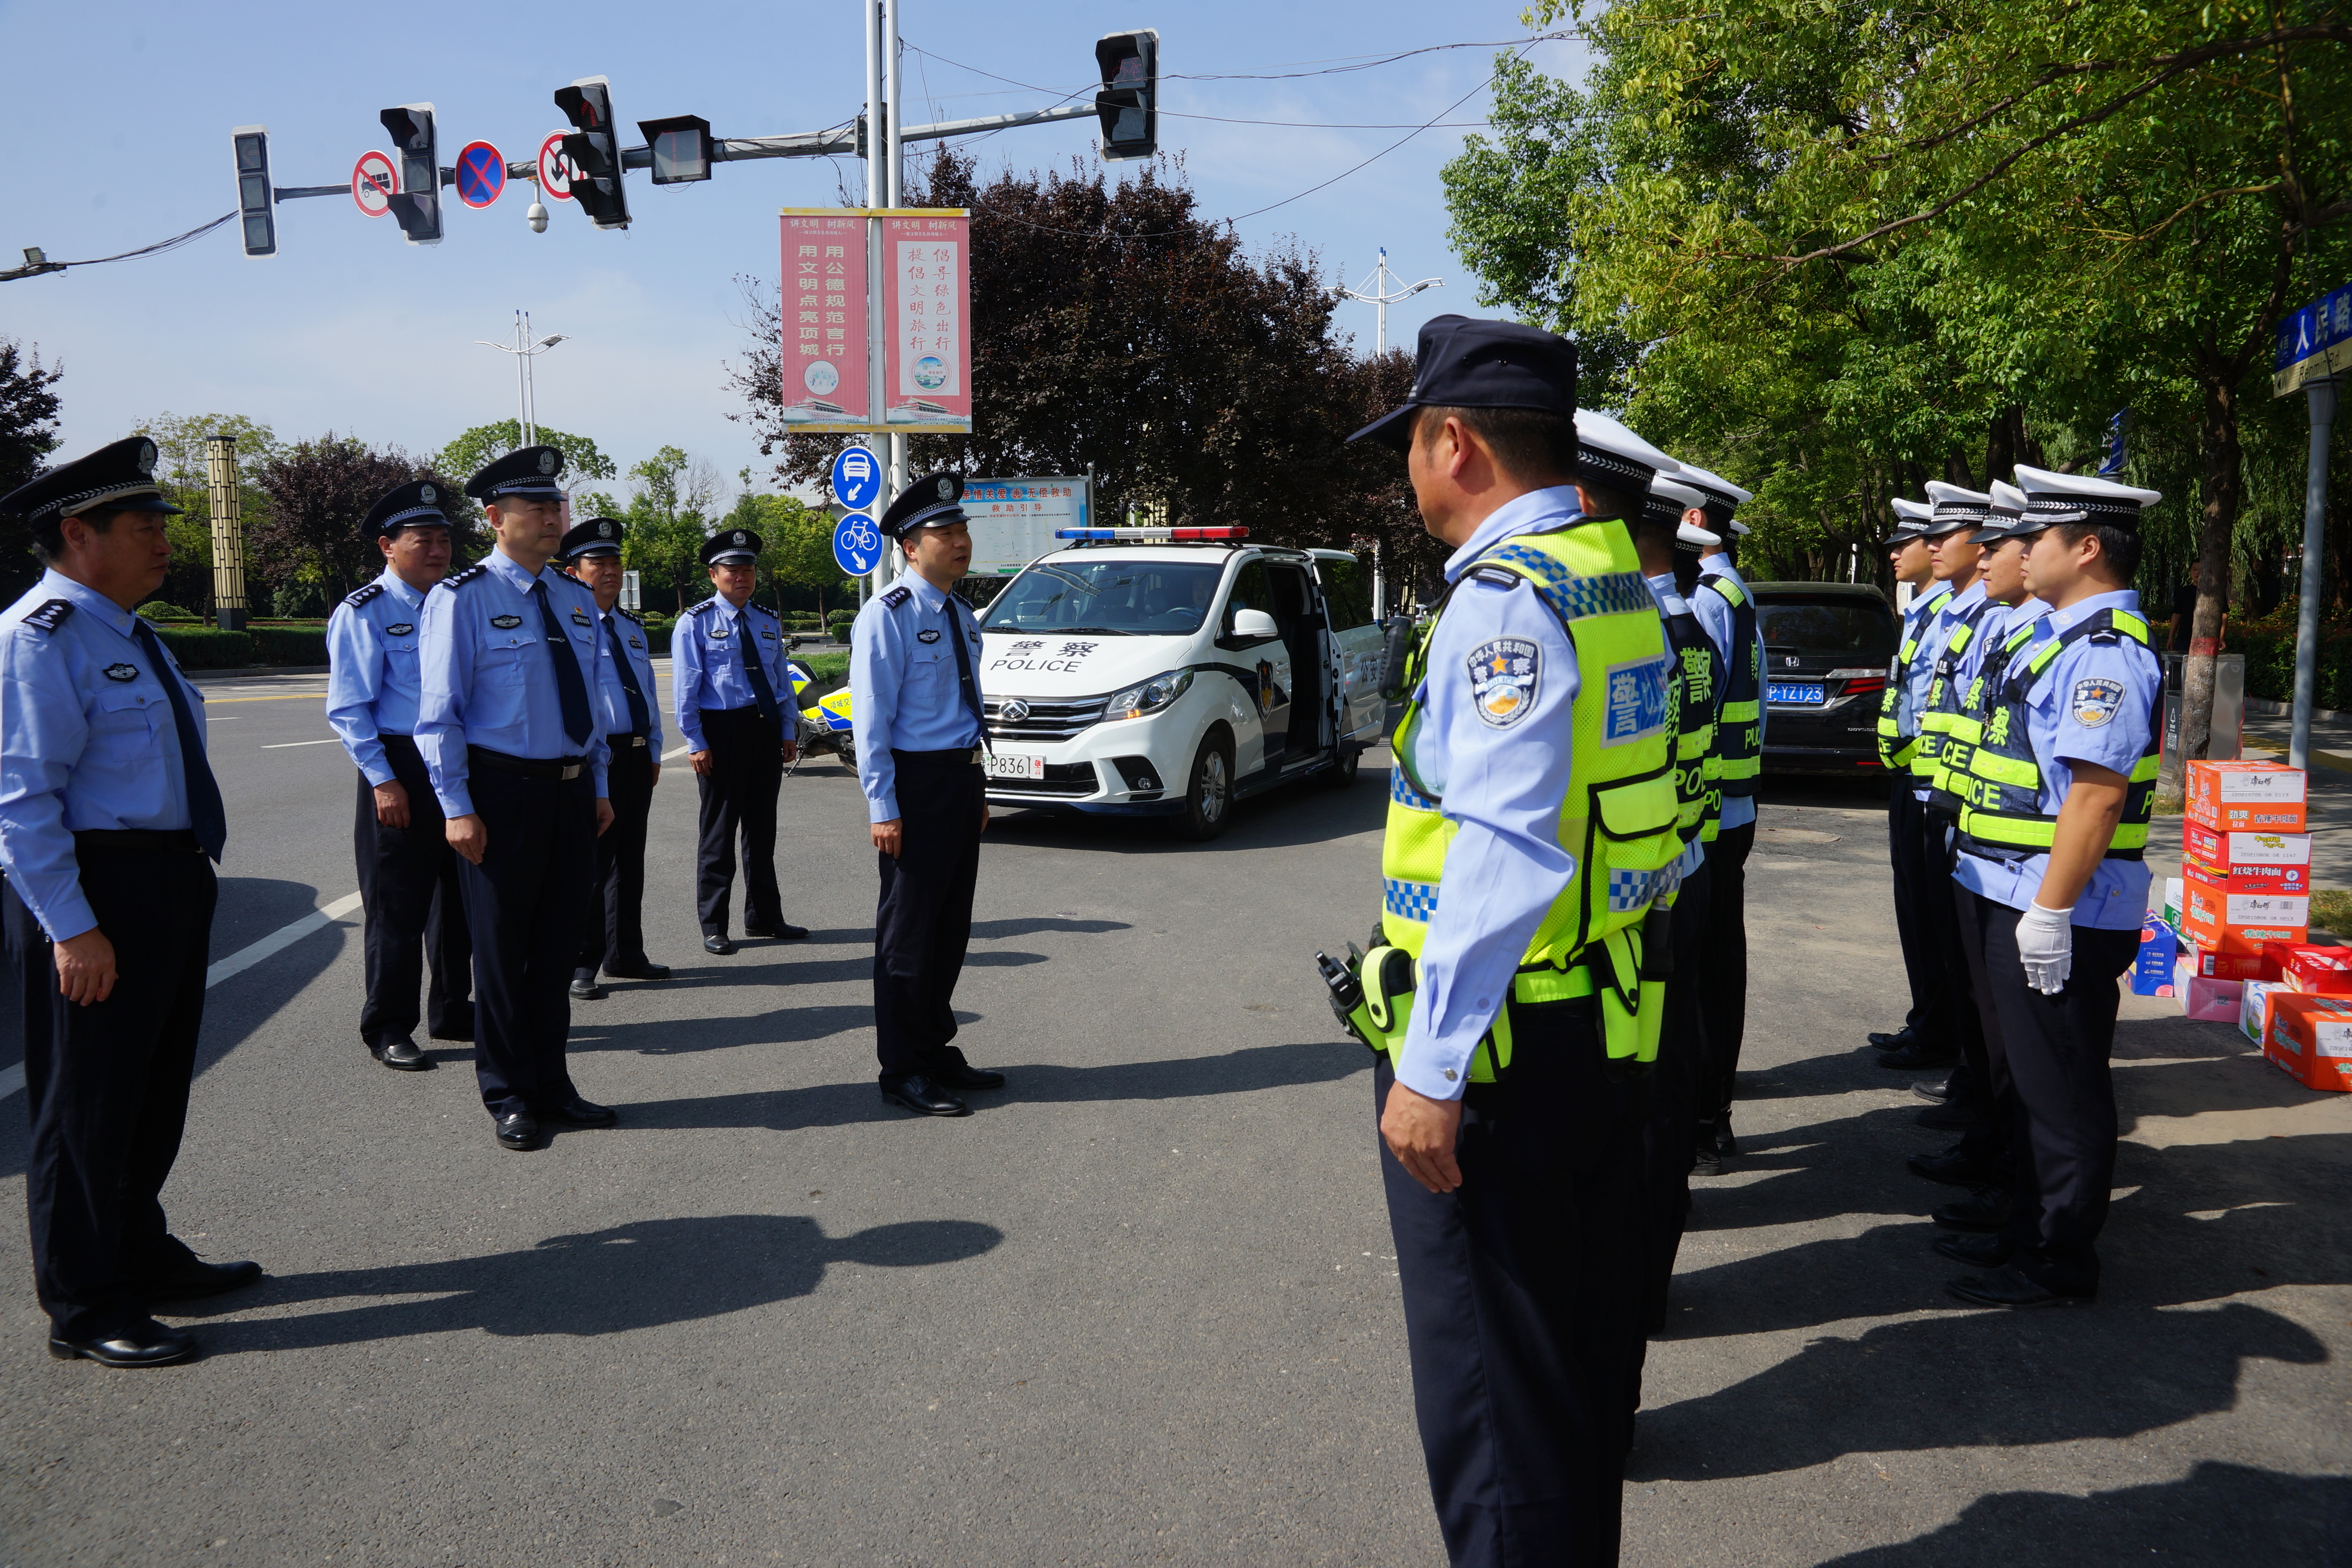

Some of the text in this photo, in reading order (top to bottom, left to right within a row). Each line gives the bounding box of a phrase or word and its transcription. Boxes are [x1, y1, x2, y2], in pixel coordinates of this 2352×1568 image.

[790, 219, 856, 229] 讲文明 树新风
[892, 220, 957, 230] 讲文明 树新风
[798, 246, 819, 356] 用文明点亮项城
[825, 246, 846, 356] 用公德规范言行
[908, 248, 926, 351] 提倡文明旅行
[932, 248, 952, 351] 倡导绿色出行
[2295, 292, 2351, 354] 人民路
[962, 487, 1071, 500] 亲情关爱 无偿救助
[992, 503, 1042, 512] 救助引导
[1005, 641, 1100, 657] 警察
[1469, 641, 1535, 668] 中华人民共和国
[990, 659, 1082, 672] POLICE
[1361, 655, 1377, 683] 公安
[1487, 676, 1516, 689] POLICE
[2077, 679, 2122, 693] 中华人民共和国
[1766, 685, 1821, 700] P·YZ123
[830, 696, 852, 709] 项城交
[1987, 706, 2010, 746] 察
[2250, 776, 2272, 786] 康师傅
[2228, 810, 2249, 819] 劲爽
[2255, 814, 2297, 823] 香辣牛肉面
[2232, 866, 2281, 876] 红烧牛肉面
[2250, 899, 2270, 909] 康师傅
[2241, 929, 2291, 939] 香辣牛肉面
